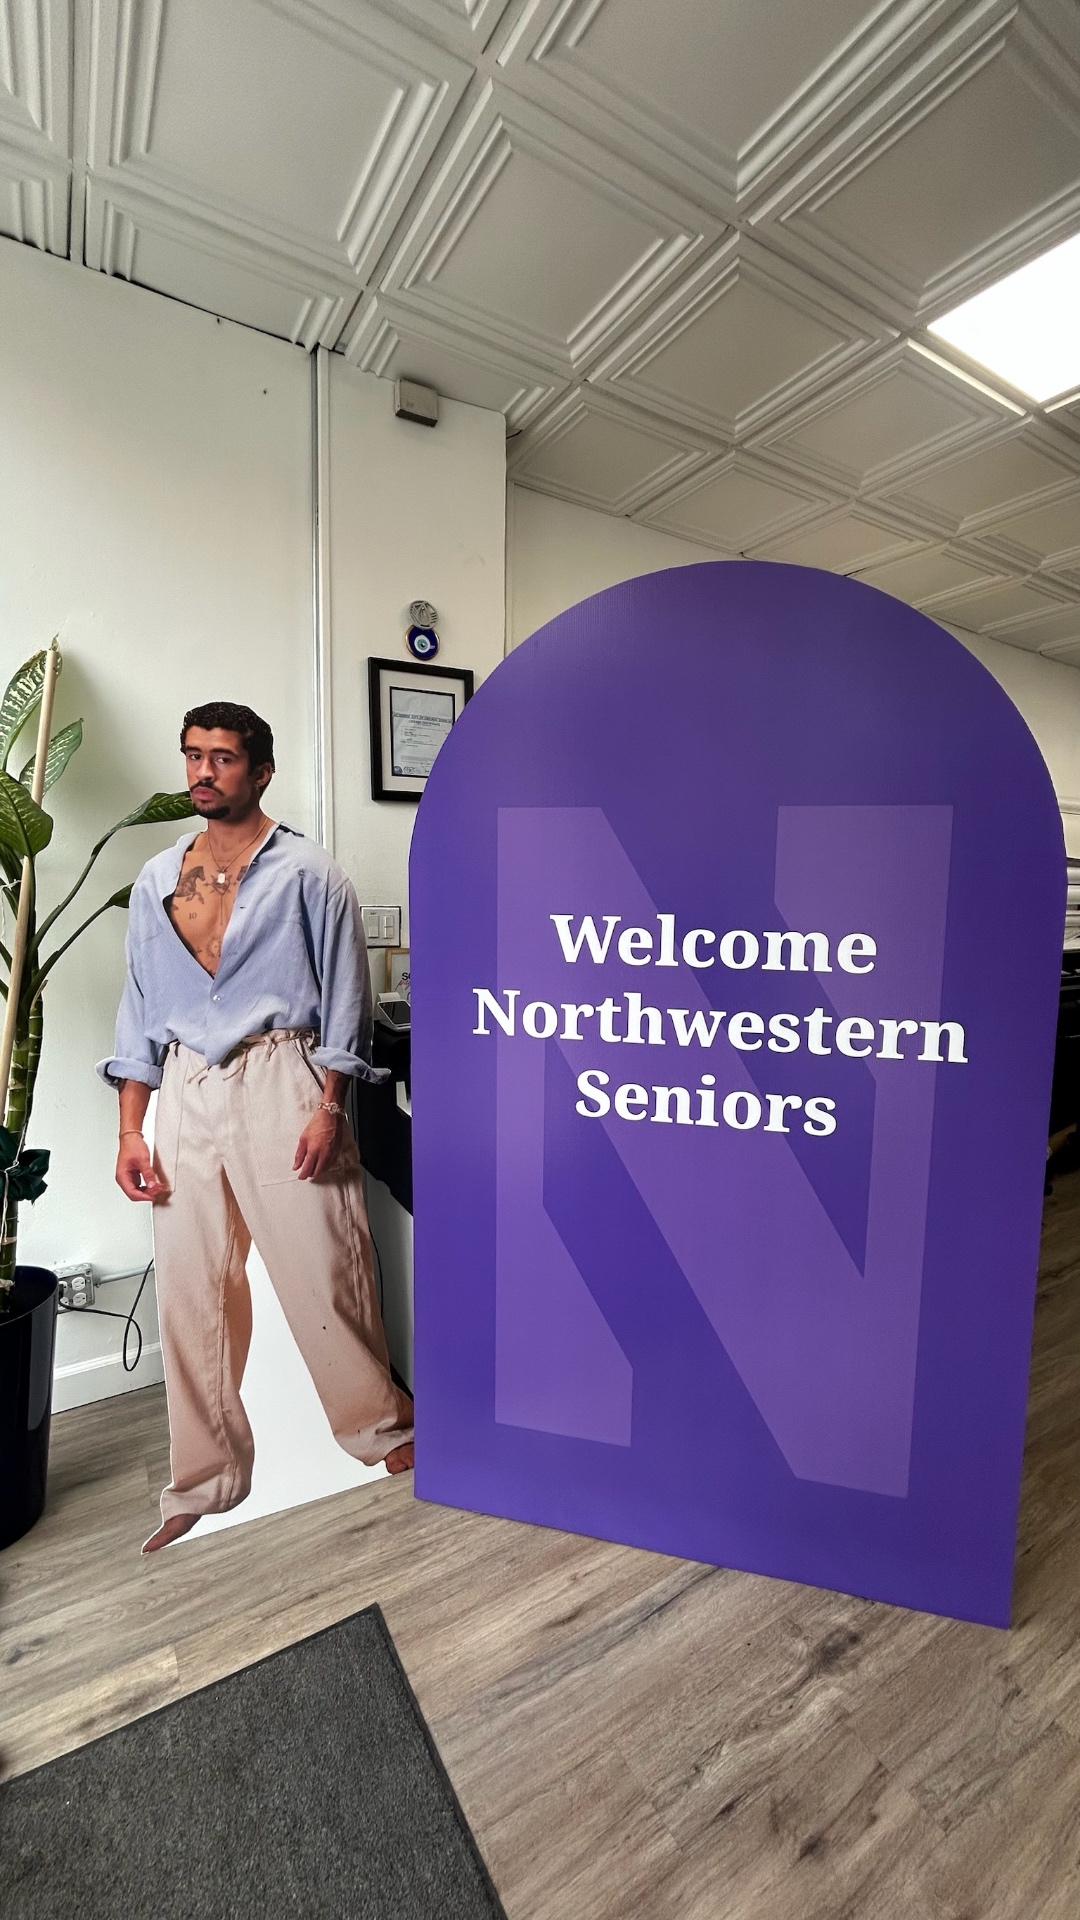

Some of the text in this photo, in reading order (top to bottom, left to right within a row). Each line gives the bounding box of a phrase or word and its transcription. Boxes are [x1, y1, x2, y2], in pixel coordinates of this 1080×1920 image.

[549, 914, 878, 974] Welcome
[472, 988, 969, 1064] Northwestern
[575, 1069, 838, 1137] Seniors
